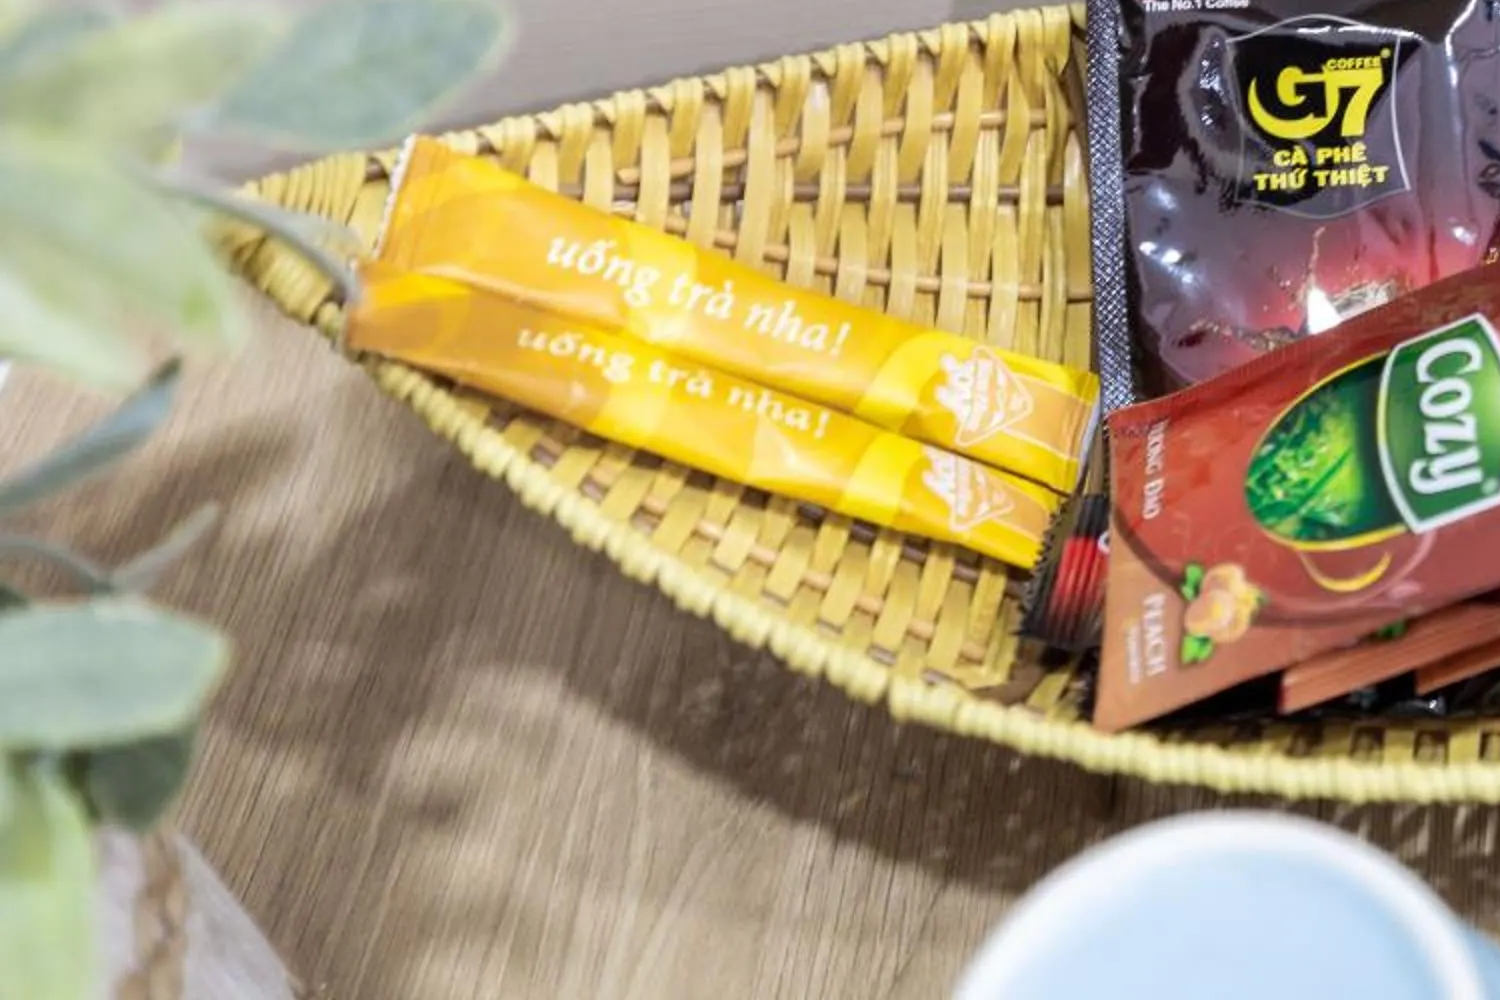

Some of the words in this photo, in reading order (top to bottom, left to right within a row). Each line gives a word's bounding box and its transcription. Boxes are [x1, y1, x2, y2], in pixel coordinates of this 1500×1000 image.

[1142, 0, 1169, 12] The
[1325, 56, 1381, 70] COFFEE
[1247, 65, 1384, 139] G7
[1272, 145, 1308, 167] CÀ
[1315, 142, 1367, 165] PHÊ
[1312, 163, 1390, 188] THIỆT
[546, 235, 662, 308] uống
[667, 273, 736, 321] trà
[743, 300, 852, 357] nha!
[516, 328, 637, 384] uống
[647, 358, 715, 399] trà
[727, 388, 832, 440] nha!
[1408, 337, 1484, 494] Cozy
